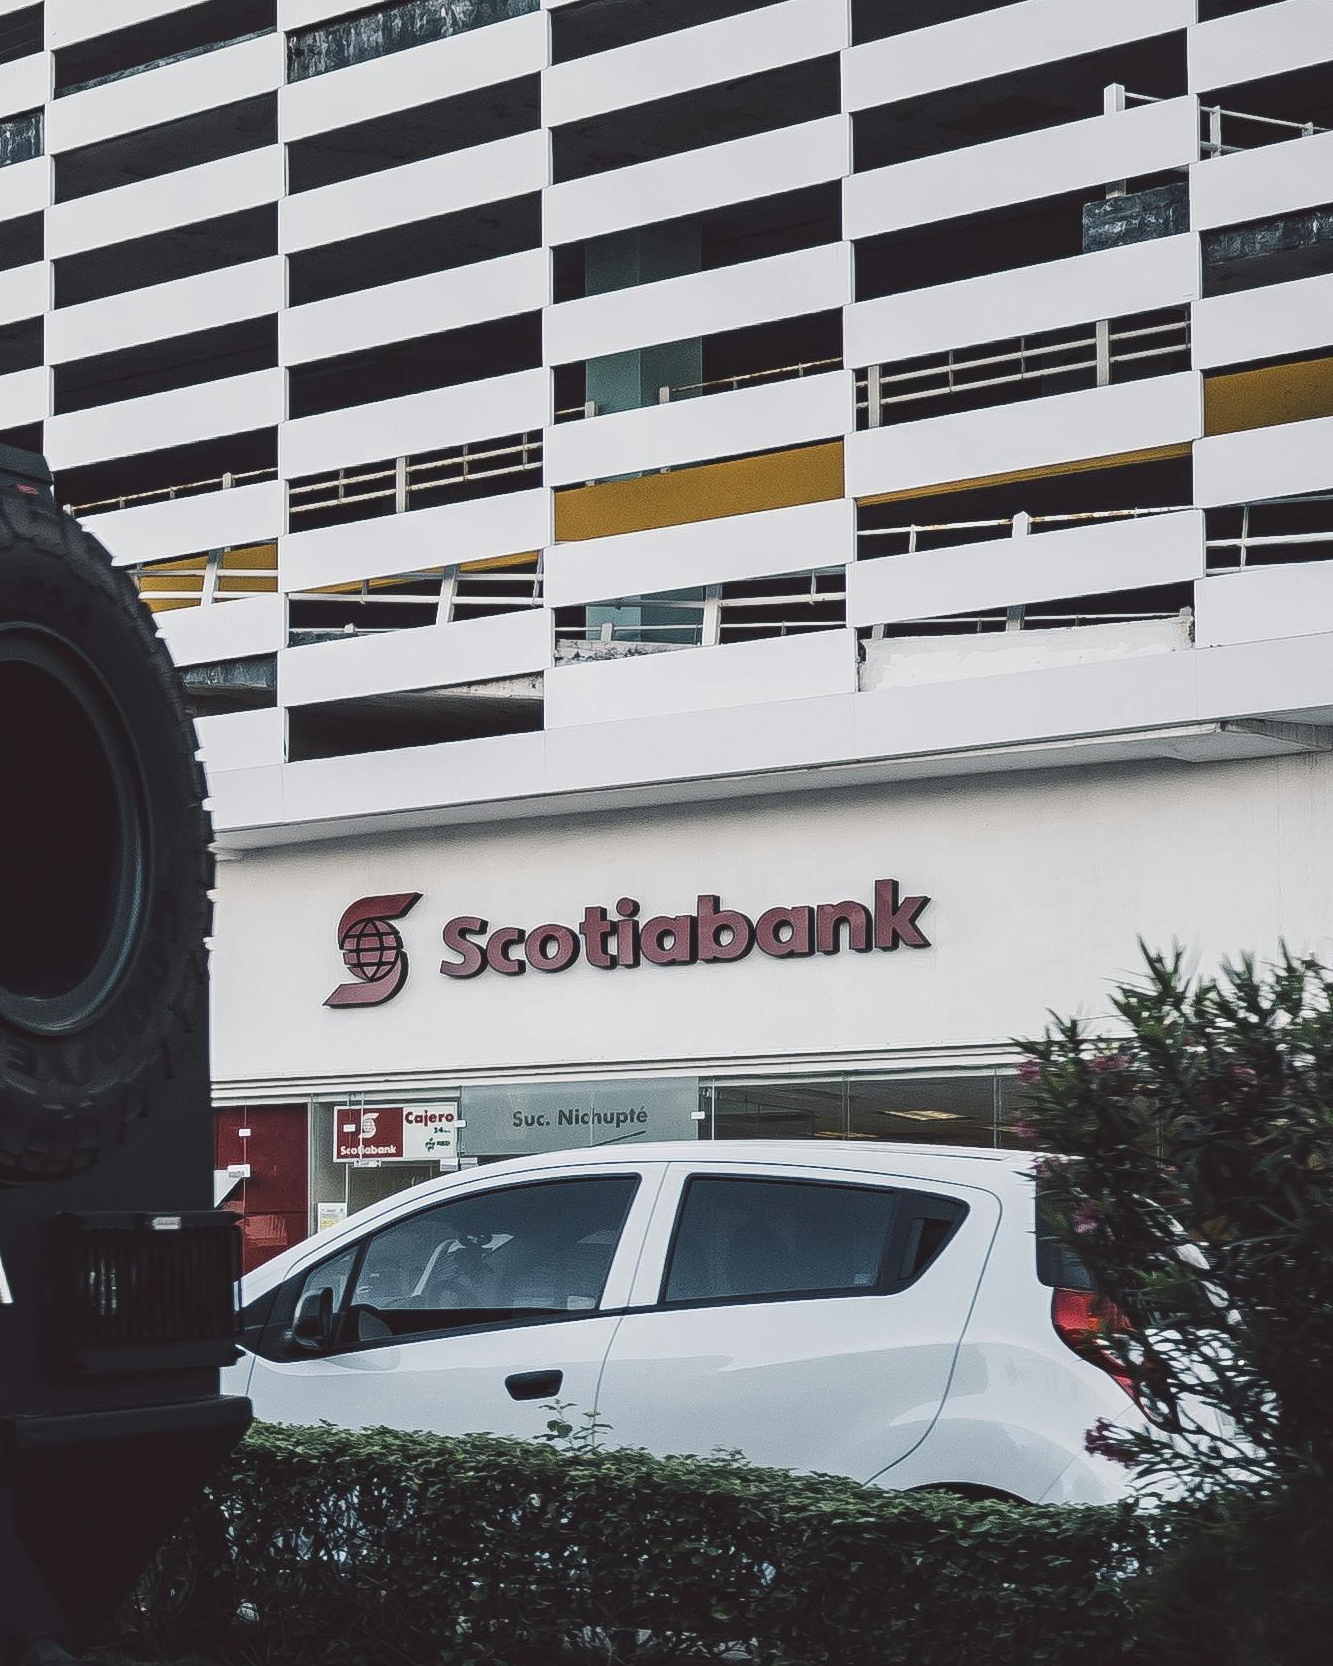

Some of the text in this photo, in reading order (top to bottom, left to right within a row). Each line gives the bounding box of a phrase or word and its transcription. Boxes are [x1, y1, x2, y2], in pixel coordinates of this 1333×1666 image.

[440, 878, 933, 980] Scotiabank
[404, 1109, 455, 1127] Cajero
[512, 1106, 649, 1129] Suc. Nichupté
